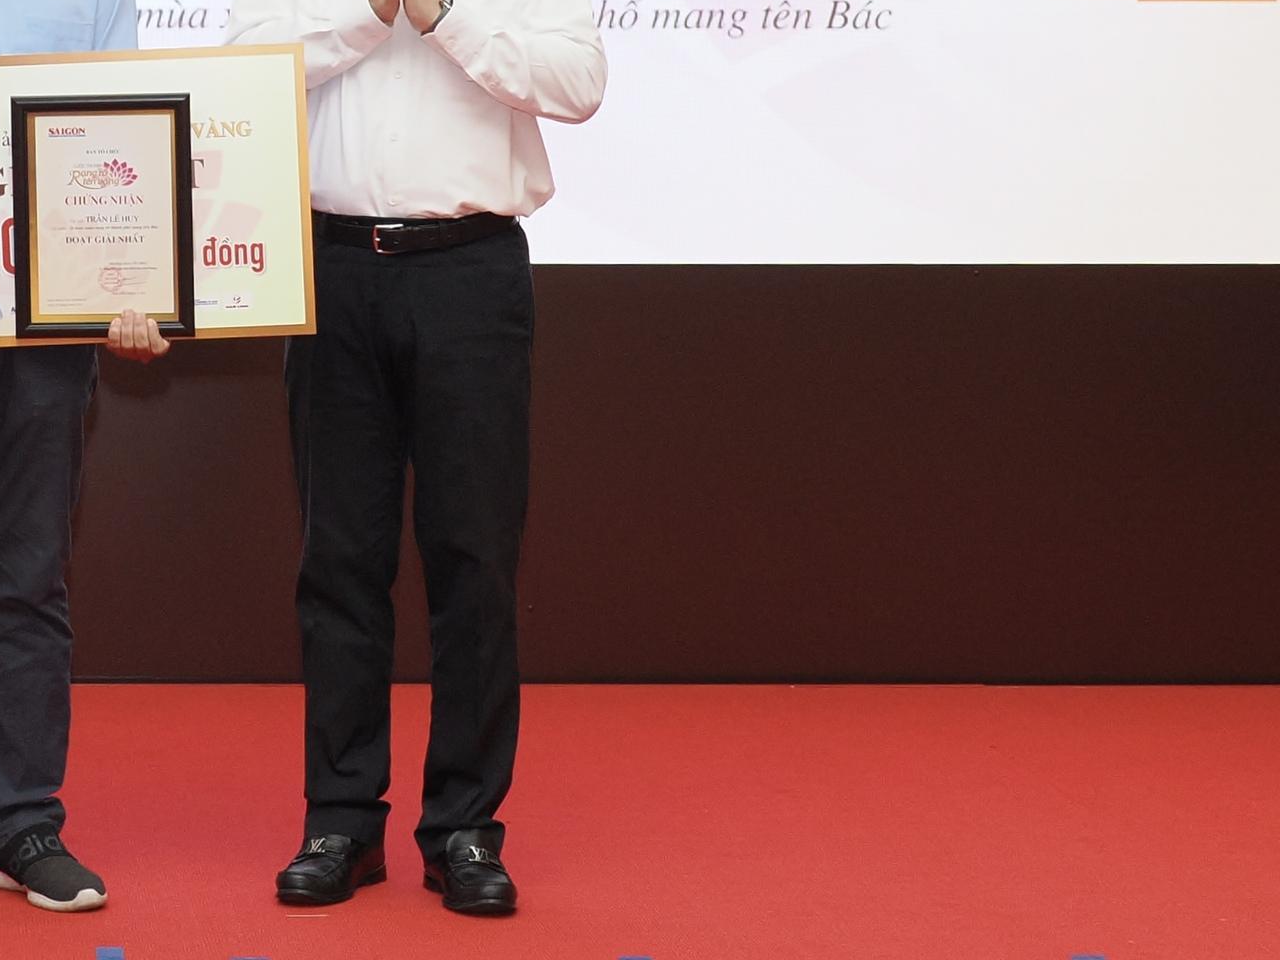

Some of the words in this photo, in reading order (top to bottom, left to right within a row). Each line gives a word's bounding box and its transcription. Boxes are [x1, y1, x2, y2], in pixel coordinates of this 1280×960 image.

[651, 6, 749, 39] mang
[761, 0, 812, 30] tên
[826, 0, 893, 31] Bác
[191, 117, 253, 139] VÀNG
[109, 193, 144, 208] NHẬN
[202, 236, 265, 273] đồng
